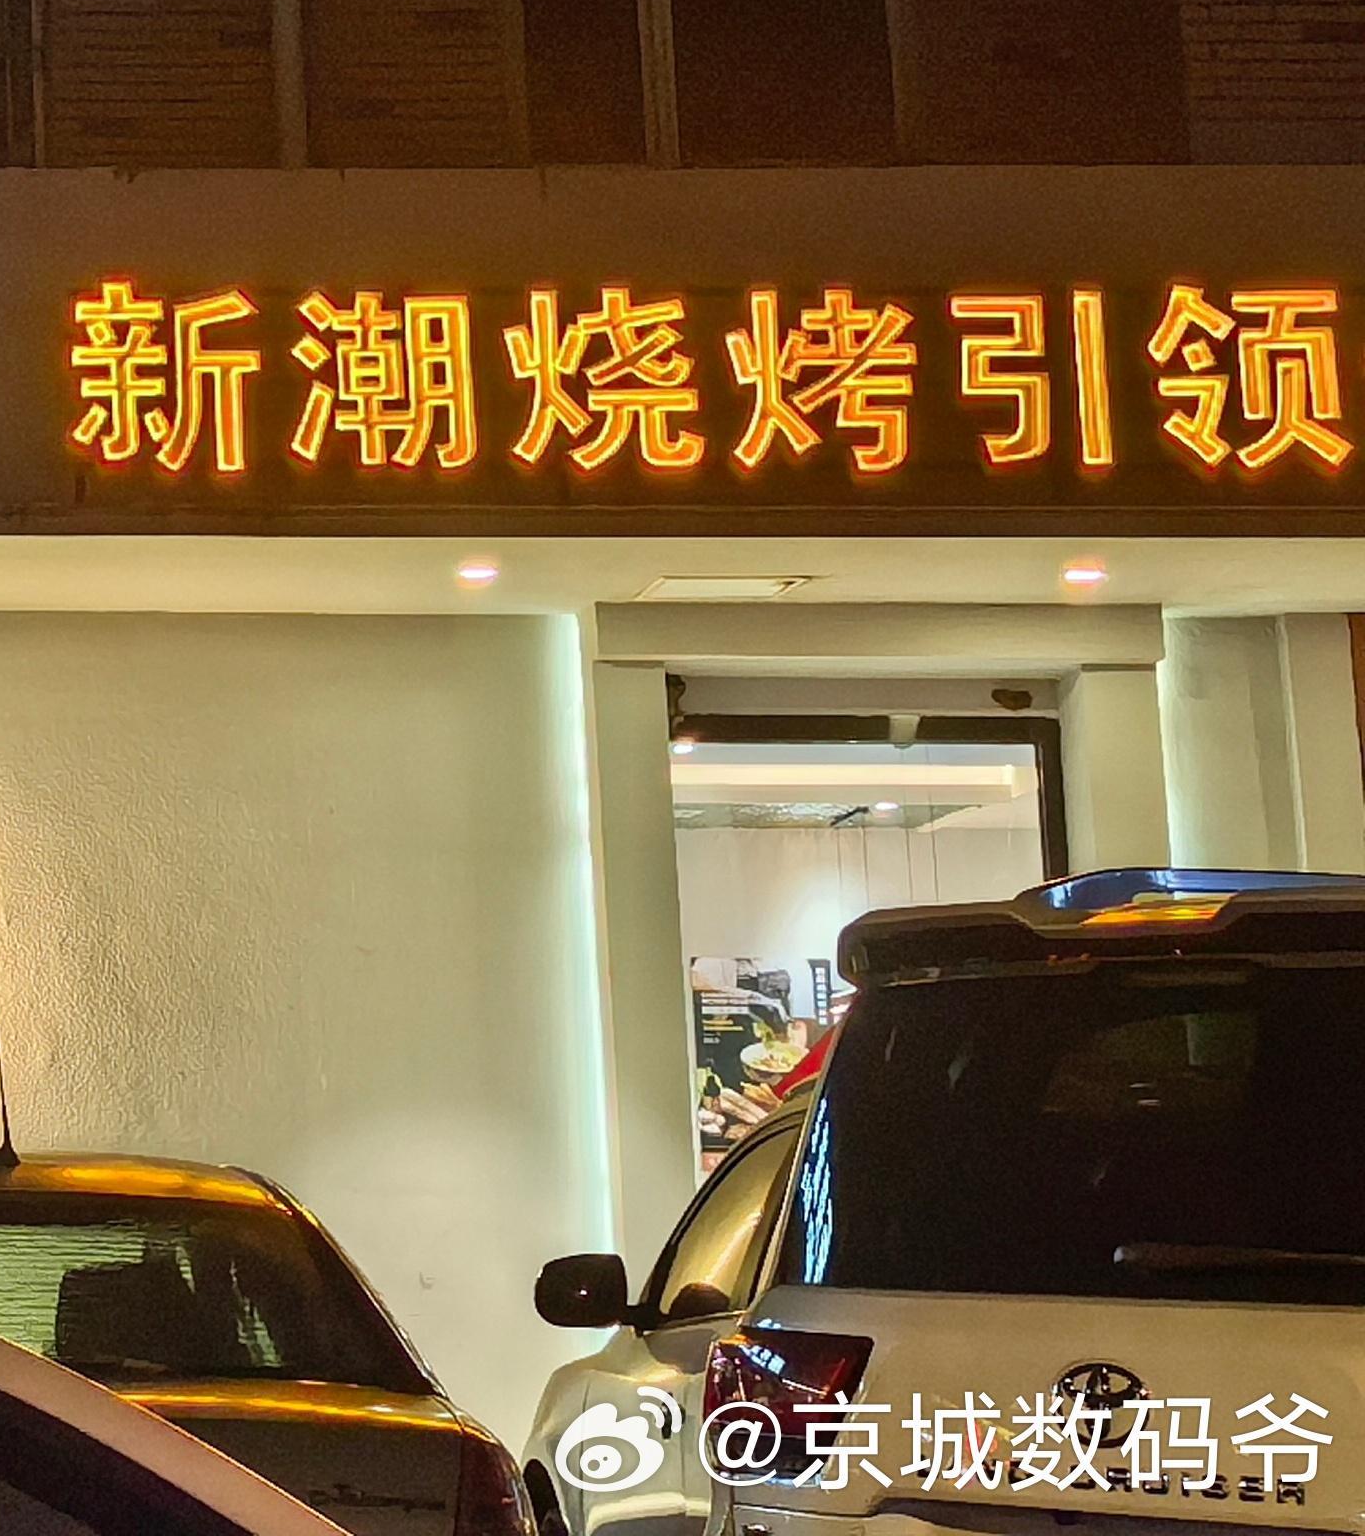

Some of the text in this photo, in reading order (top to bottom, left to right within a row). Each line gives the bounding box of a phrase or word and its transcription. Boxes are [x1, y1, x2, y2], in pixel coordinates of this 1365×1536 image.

[71, 280, 1353, 470] 新潮烧烤引领
